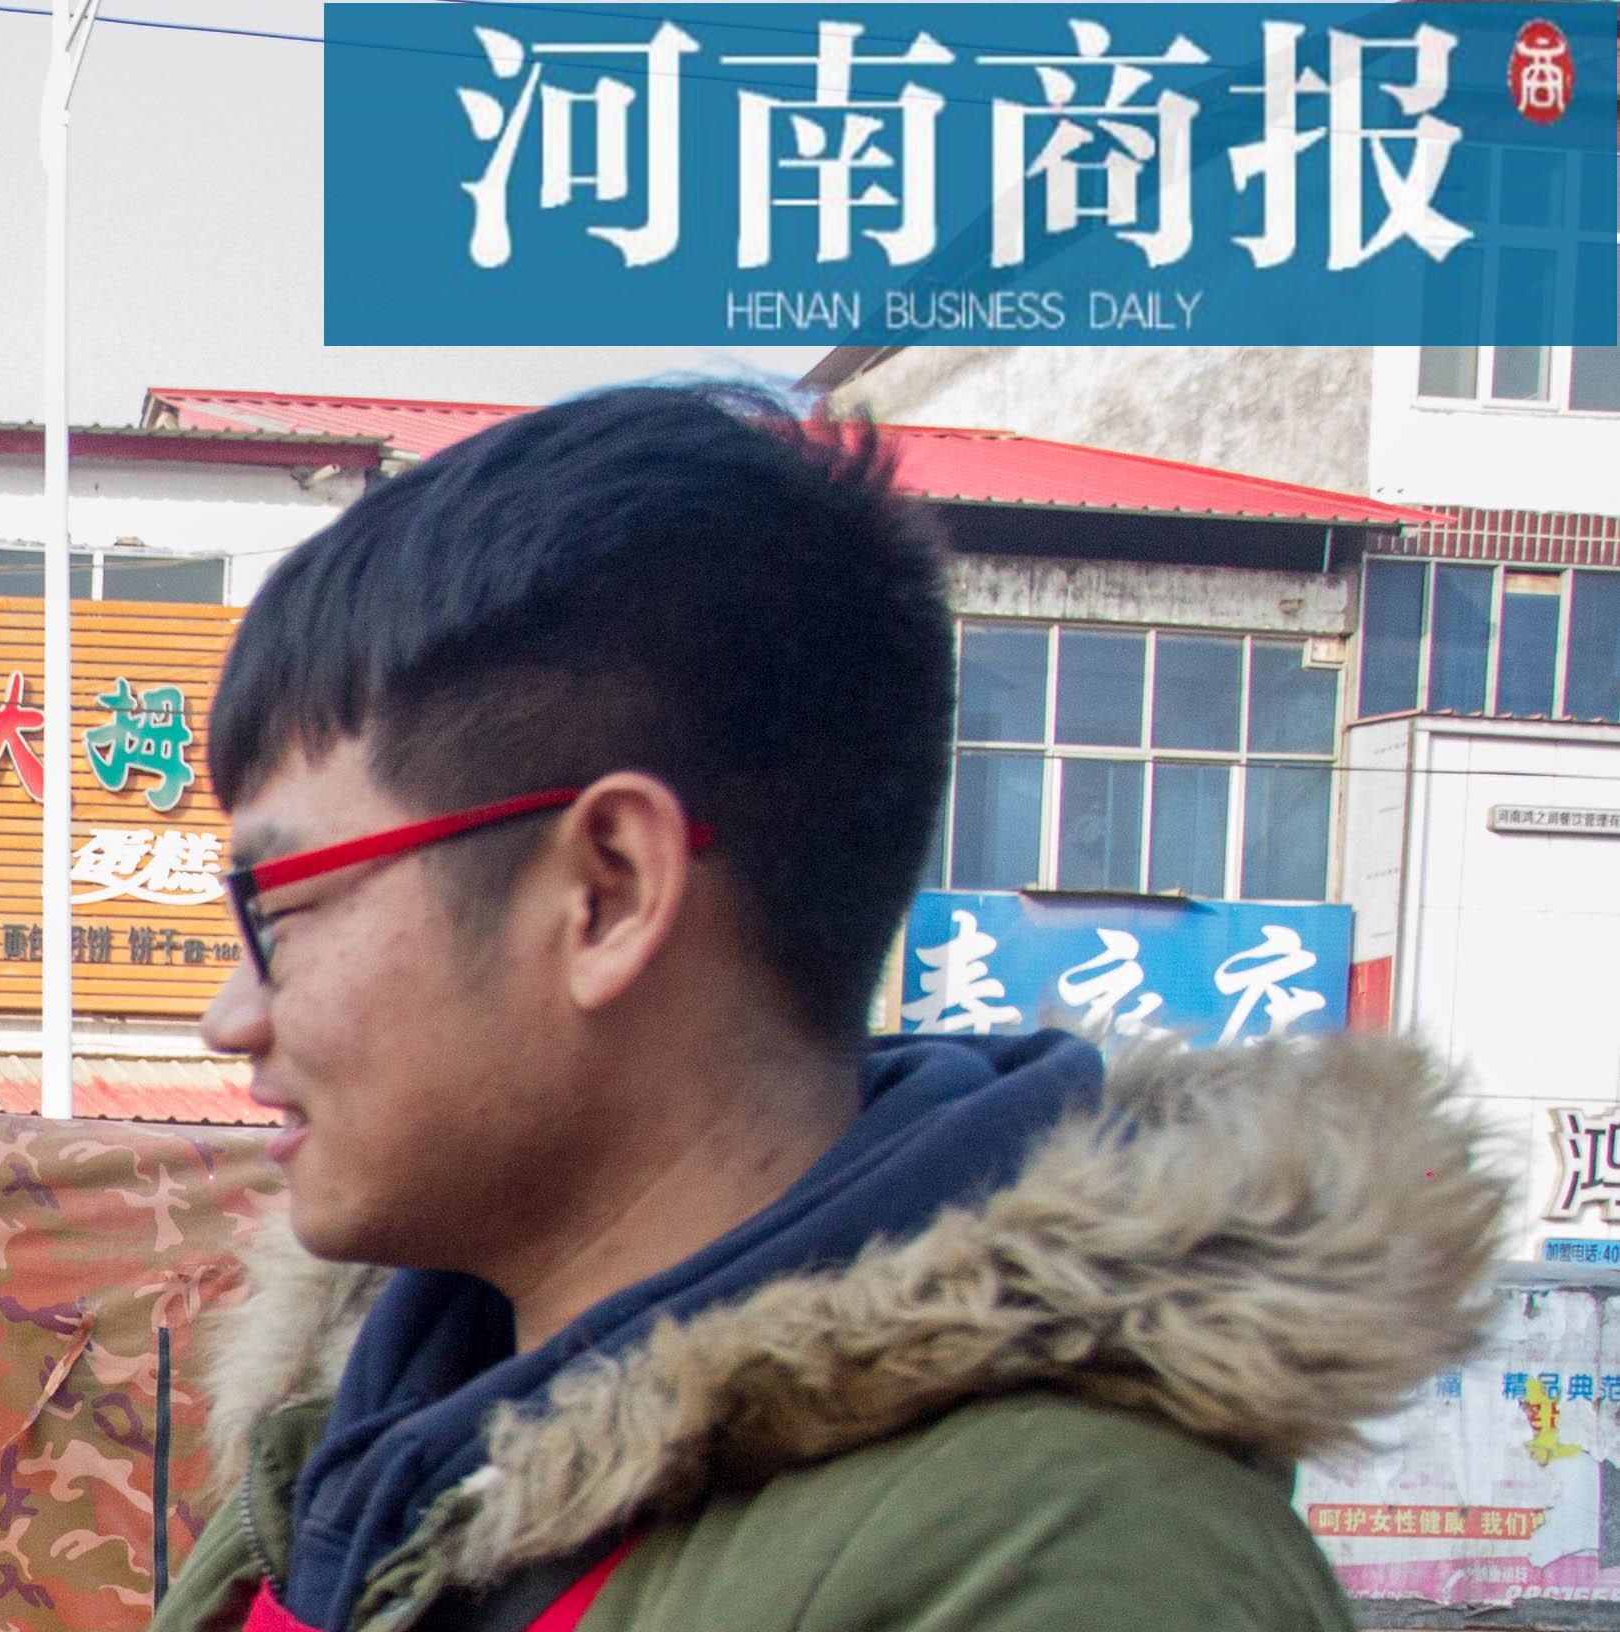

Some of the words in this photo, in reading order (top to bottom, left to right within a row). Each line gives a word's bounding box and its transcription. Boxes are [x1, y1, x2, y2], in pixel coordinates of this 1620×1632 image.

[71, 829, 227, 905] 蛋糕
[1318, 1508, 1466, 1536] 呵护女性健康
[1480, 1512, 1546, 1537] 我们
